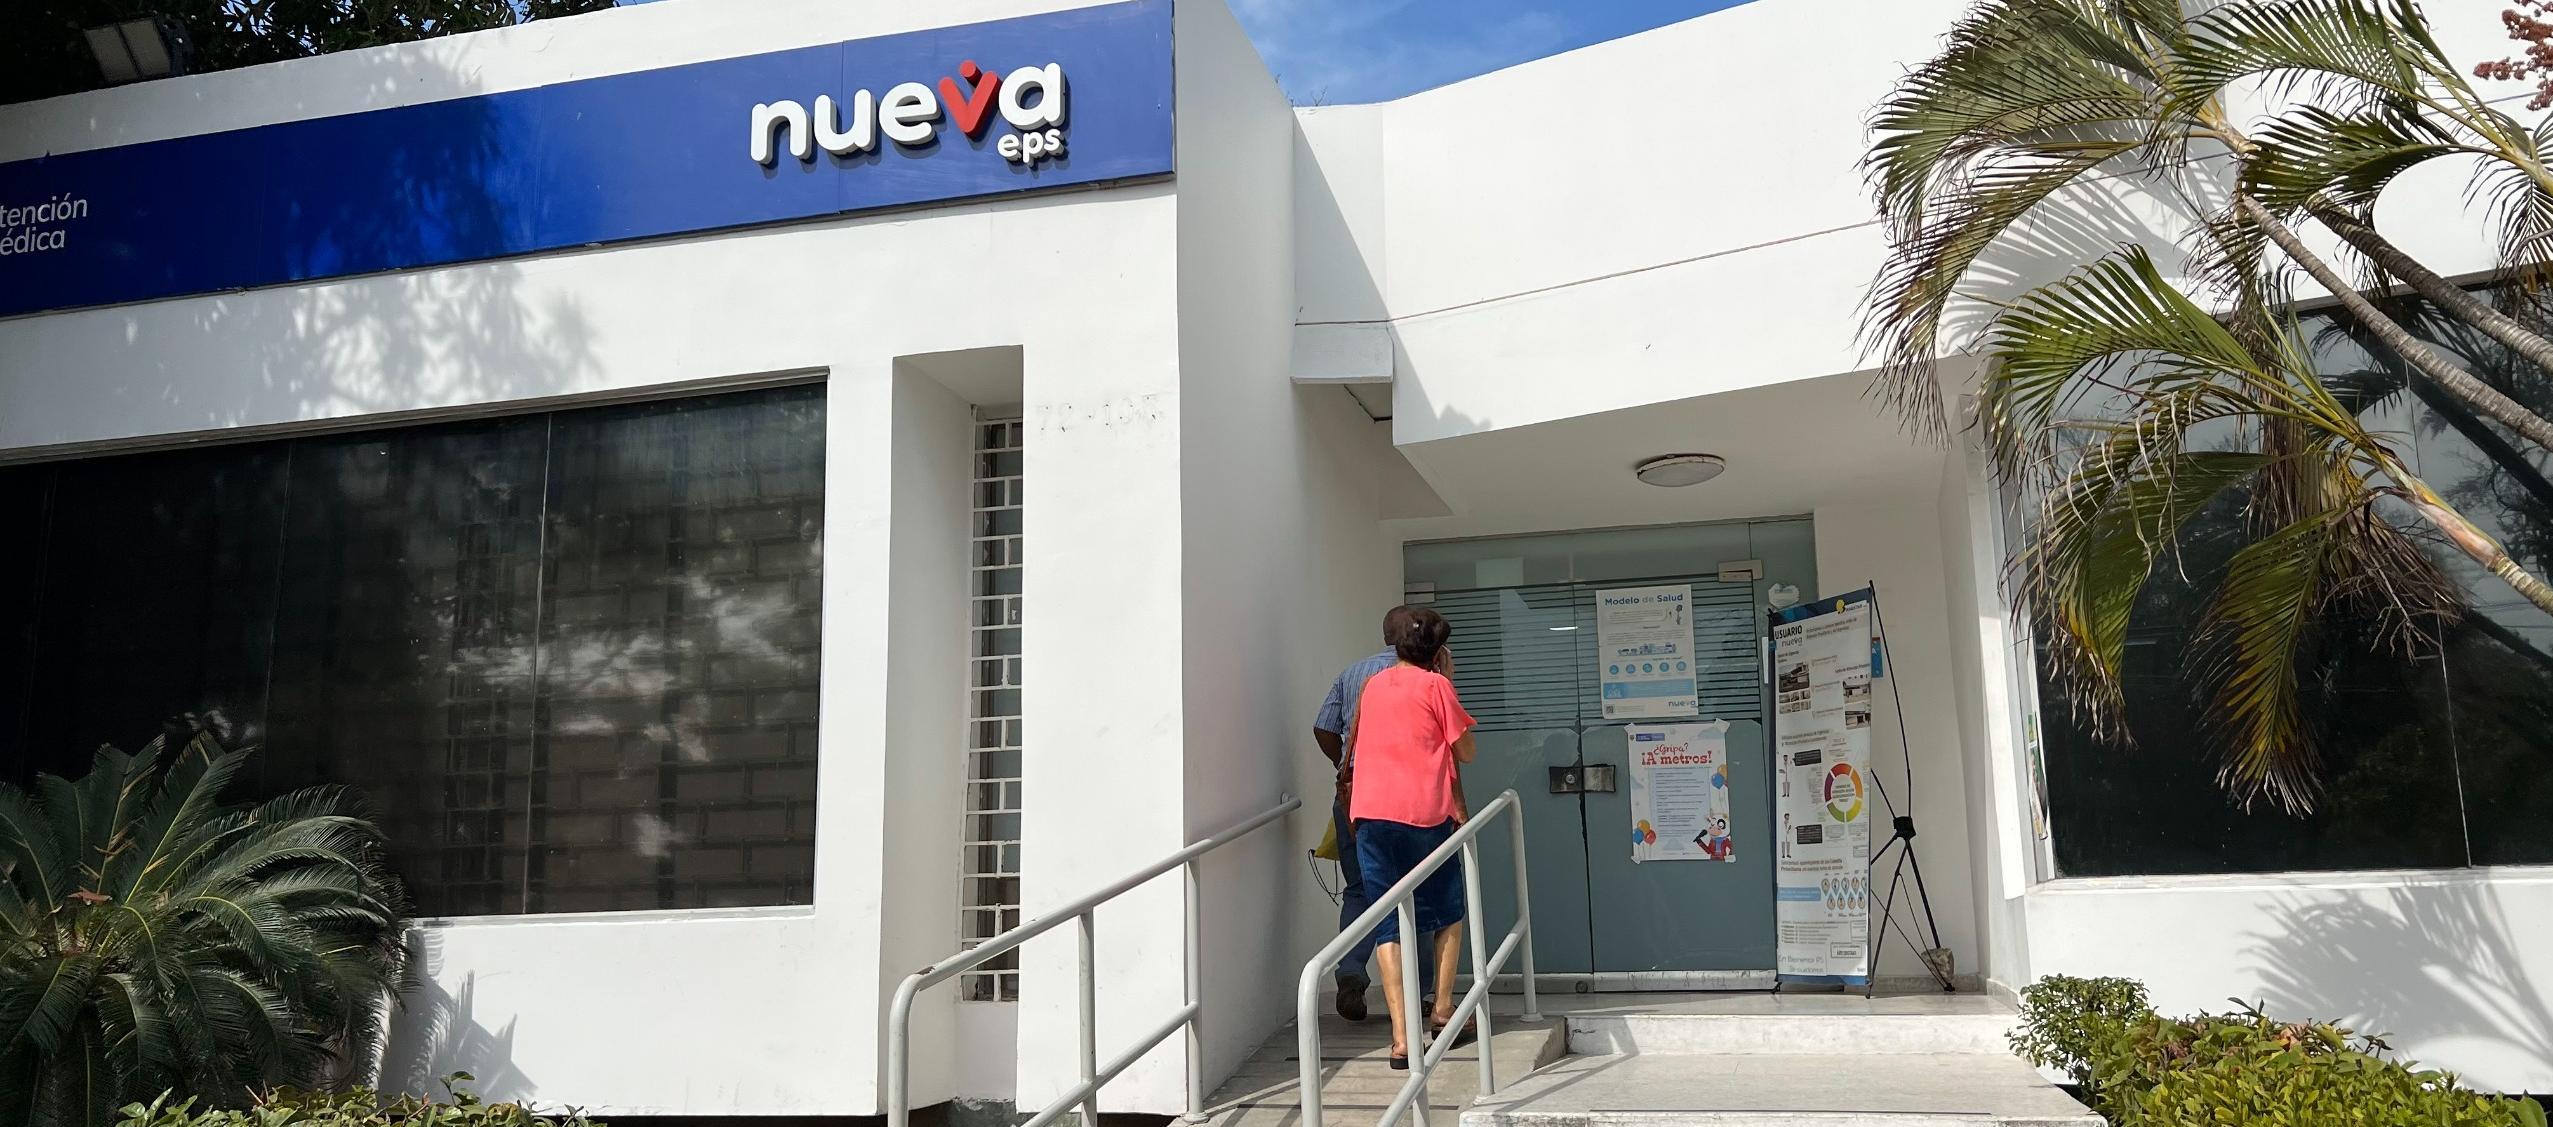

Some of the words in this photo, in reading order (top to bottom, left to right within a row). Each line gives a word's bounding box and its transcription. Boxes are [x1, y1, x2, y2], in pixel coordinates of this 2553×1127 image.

[750, 59, 1067, 165] nueva
[997, 127, 1065, 165] eps
[1604, 596, 1640, 606] Modelo
[1642, 595, 1654, 604] de
[1657, 593, 1683, 603] Salud
[1774, 625, 1803, 639] USUARIO
[1653, 742, 1689, 755] ¿Gripa?
[1641, 752, 1657, 766] ¡A
[1660, 751, 1713, 765] metros!
